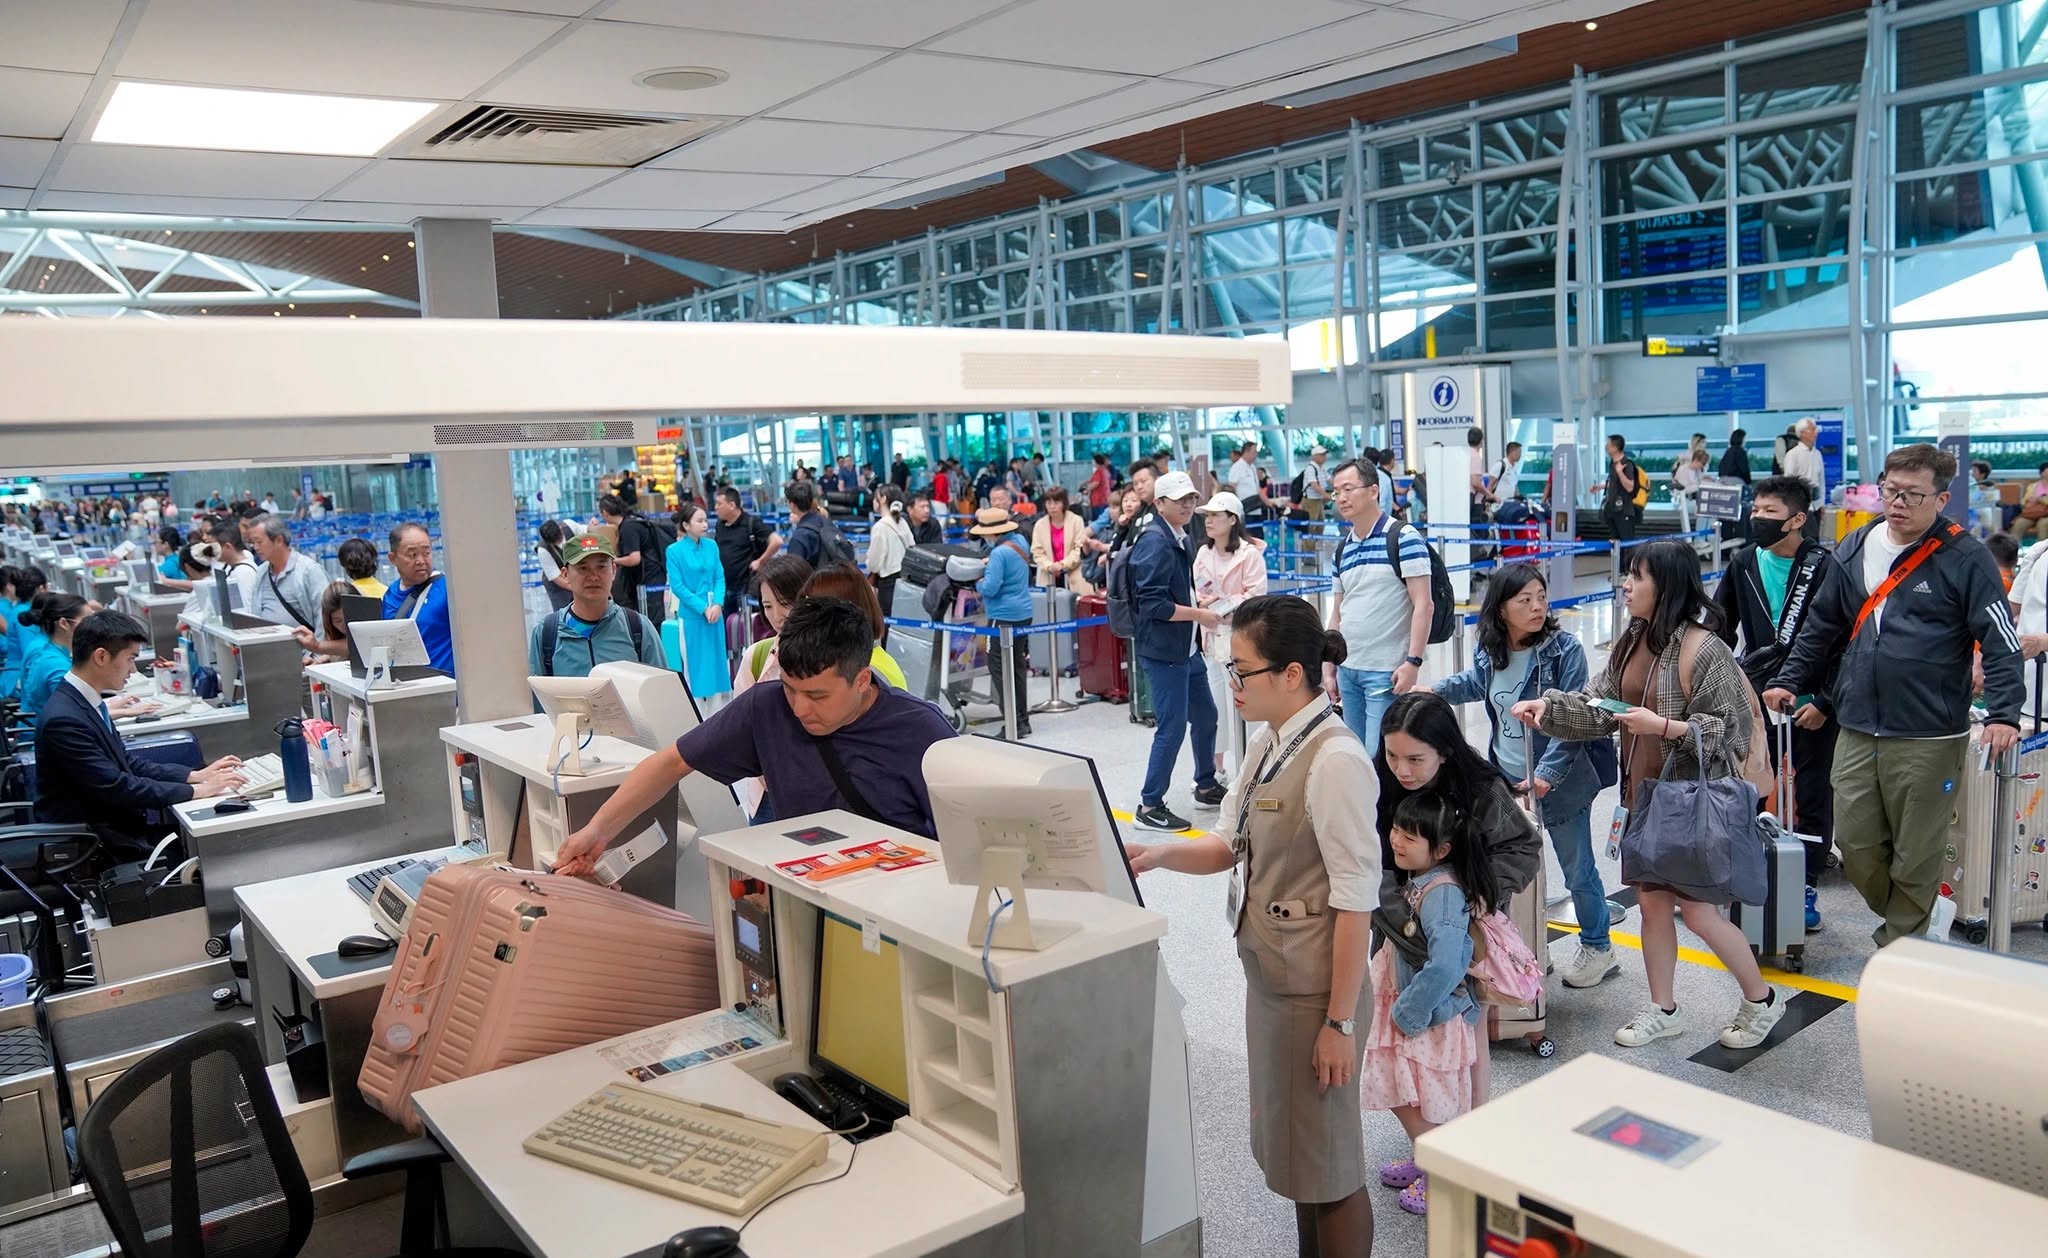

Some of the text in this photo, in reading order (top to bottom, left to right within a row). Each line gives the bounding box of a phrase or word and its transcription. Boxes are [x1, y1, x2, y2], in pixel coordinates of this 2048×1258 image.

[1417, 416, 1474, 426] INFORMATION
[1779, 583, 1809, 645] UMPMAN.
[1278, 734, 1305, 763] STARLUX
